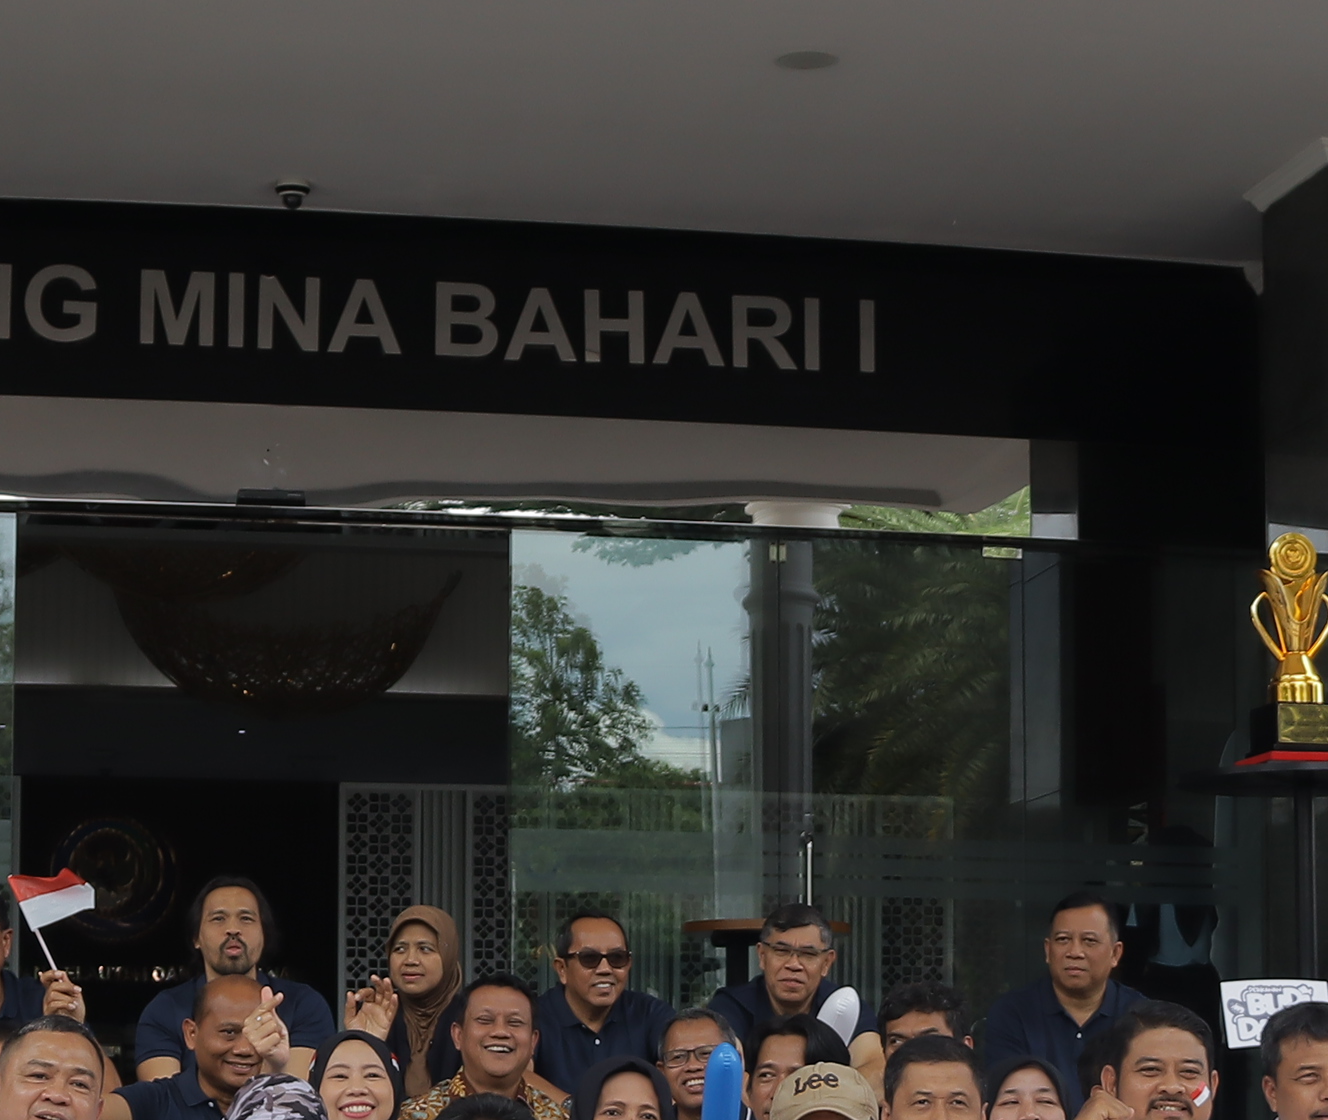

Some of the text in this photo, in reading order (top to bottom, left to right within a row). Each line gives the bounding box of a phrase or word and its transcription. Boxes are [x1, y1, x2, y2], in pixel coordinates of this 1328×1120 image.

[140, 268, 401, 354] MINA
[435, 281, 820, 371] BAHARI
[860, 299, 875, 372] I
[1246, 987, 1311, 1016] BUD
[793, 1073, 839, 1096] Lee
